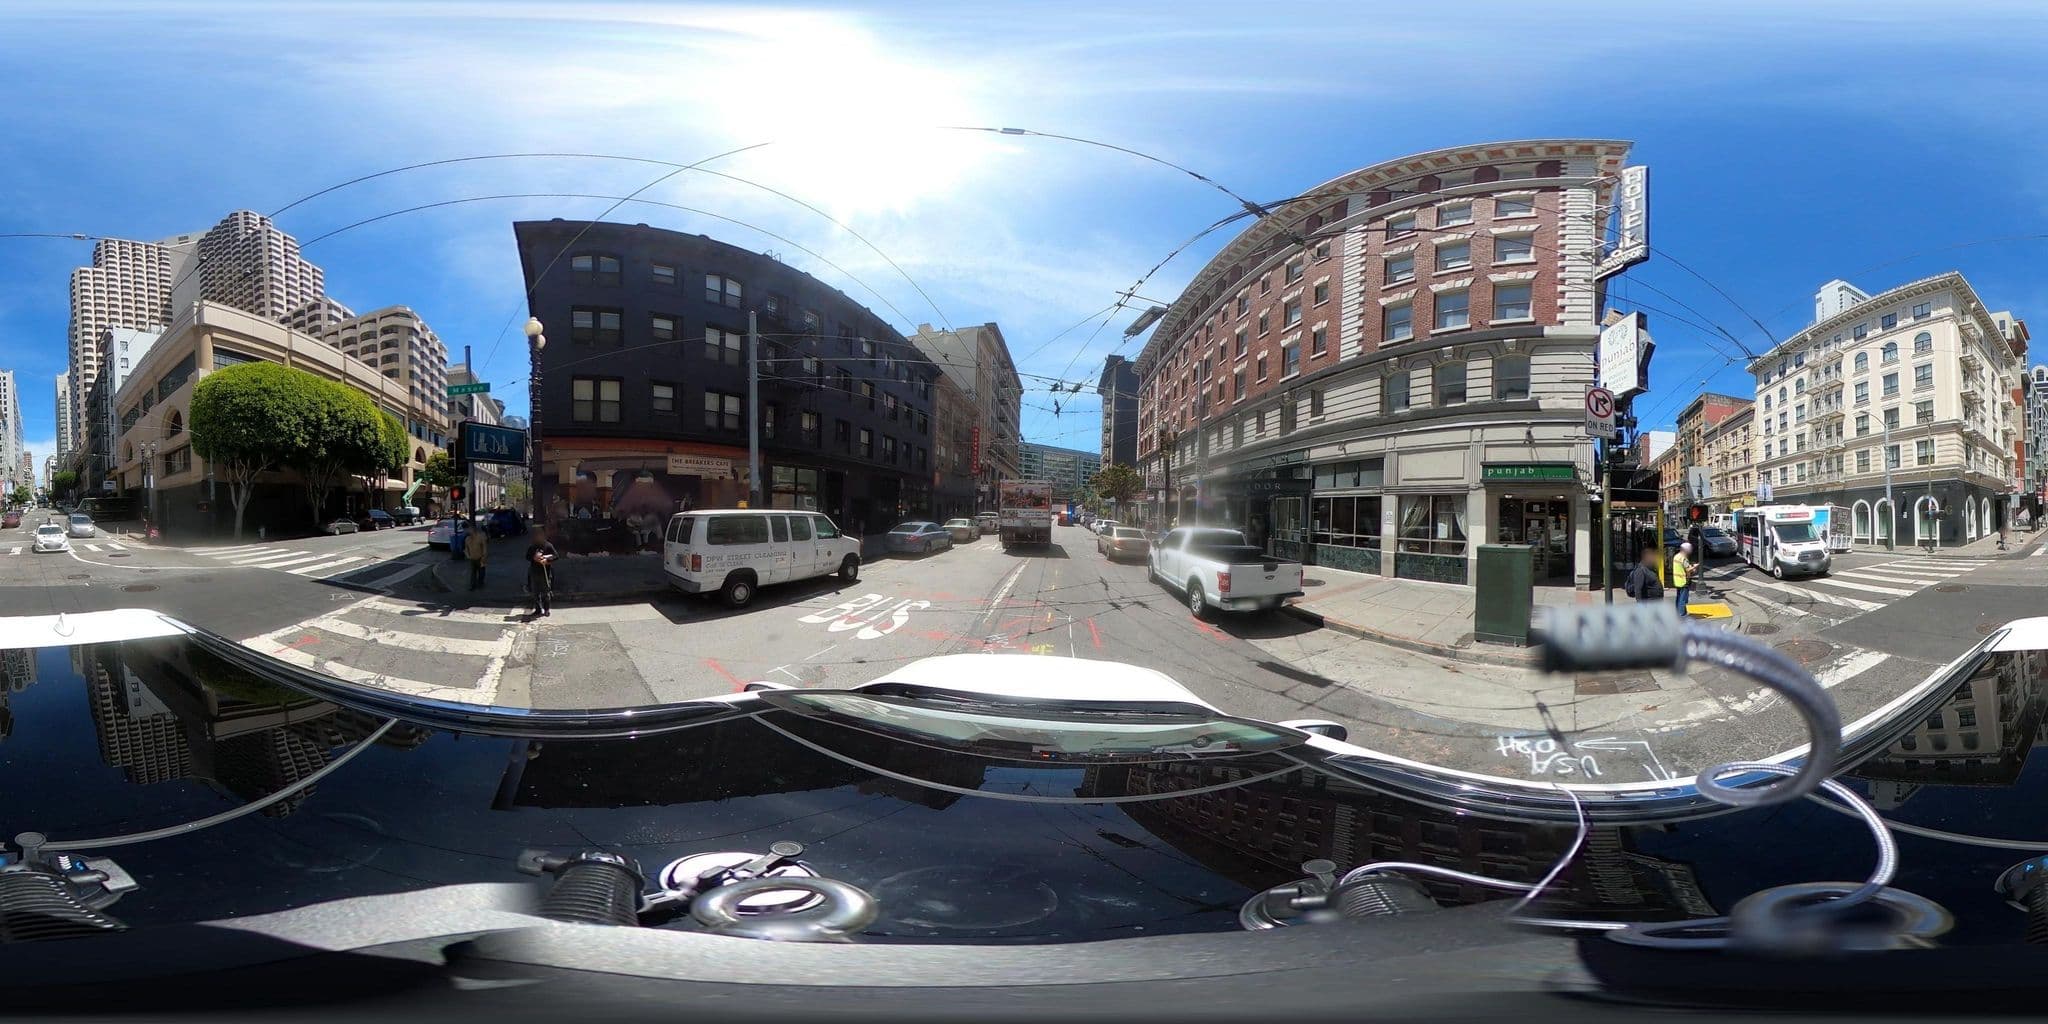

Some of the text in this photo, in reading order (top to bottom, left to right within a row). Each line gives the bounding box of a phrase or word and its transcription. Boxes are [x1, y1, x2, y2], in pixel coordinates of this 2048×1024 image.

[1624, 171, 1643, 248] HOTEL
[452, 385, 484, 393] Mason
[1588, 420, 1613, 432] ON RED
[1487, 466, 1534, 477] punjab
[727, 553, 752, 561] STREET
[797, 593, 931, 640] BUS
[1531, 752, 1603, 779] USA
